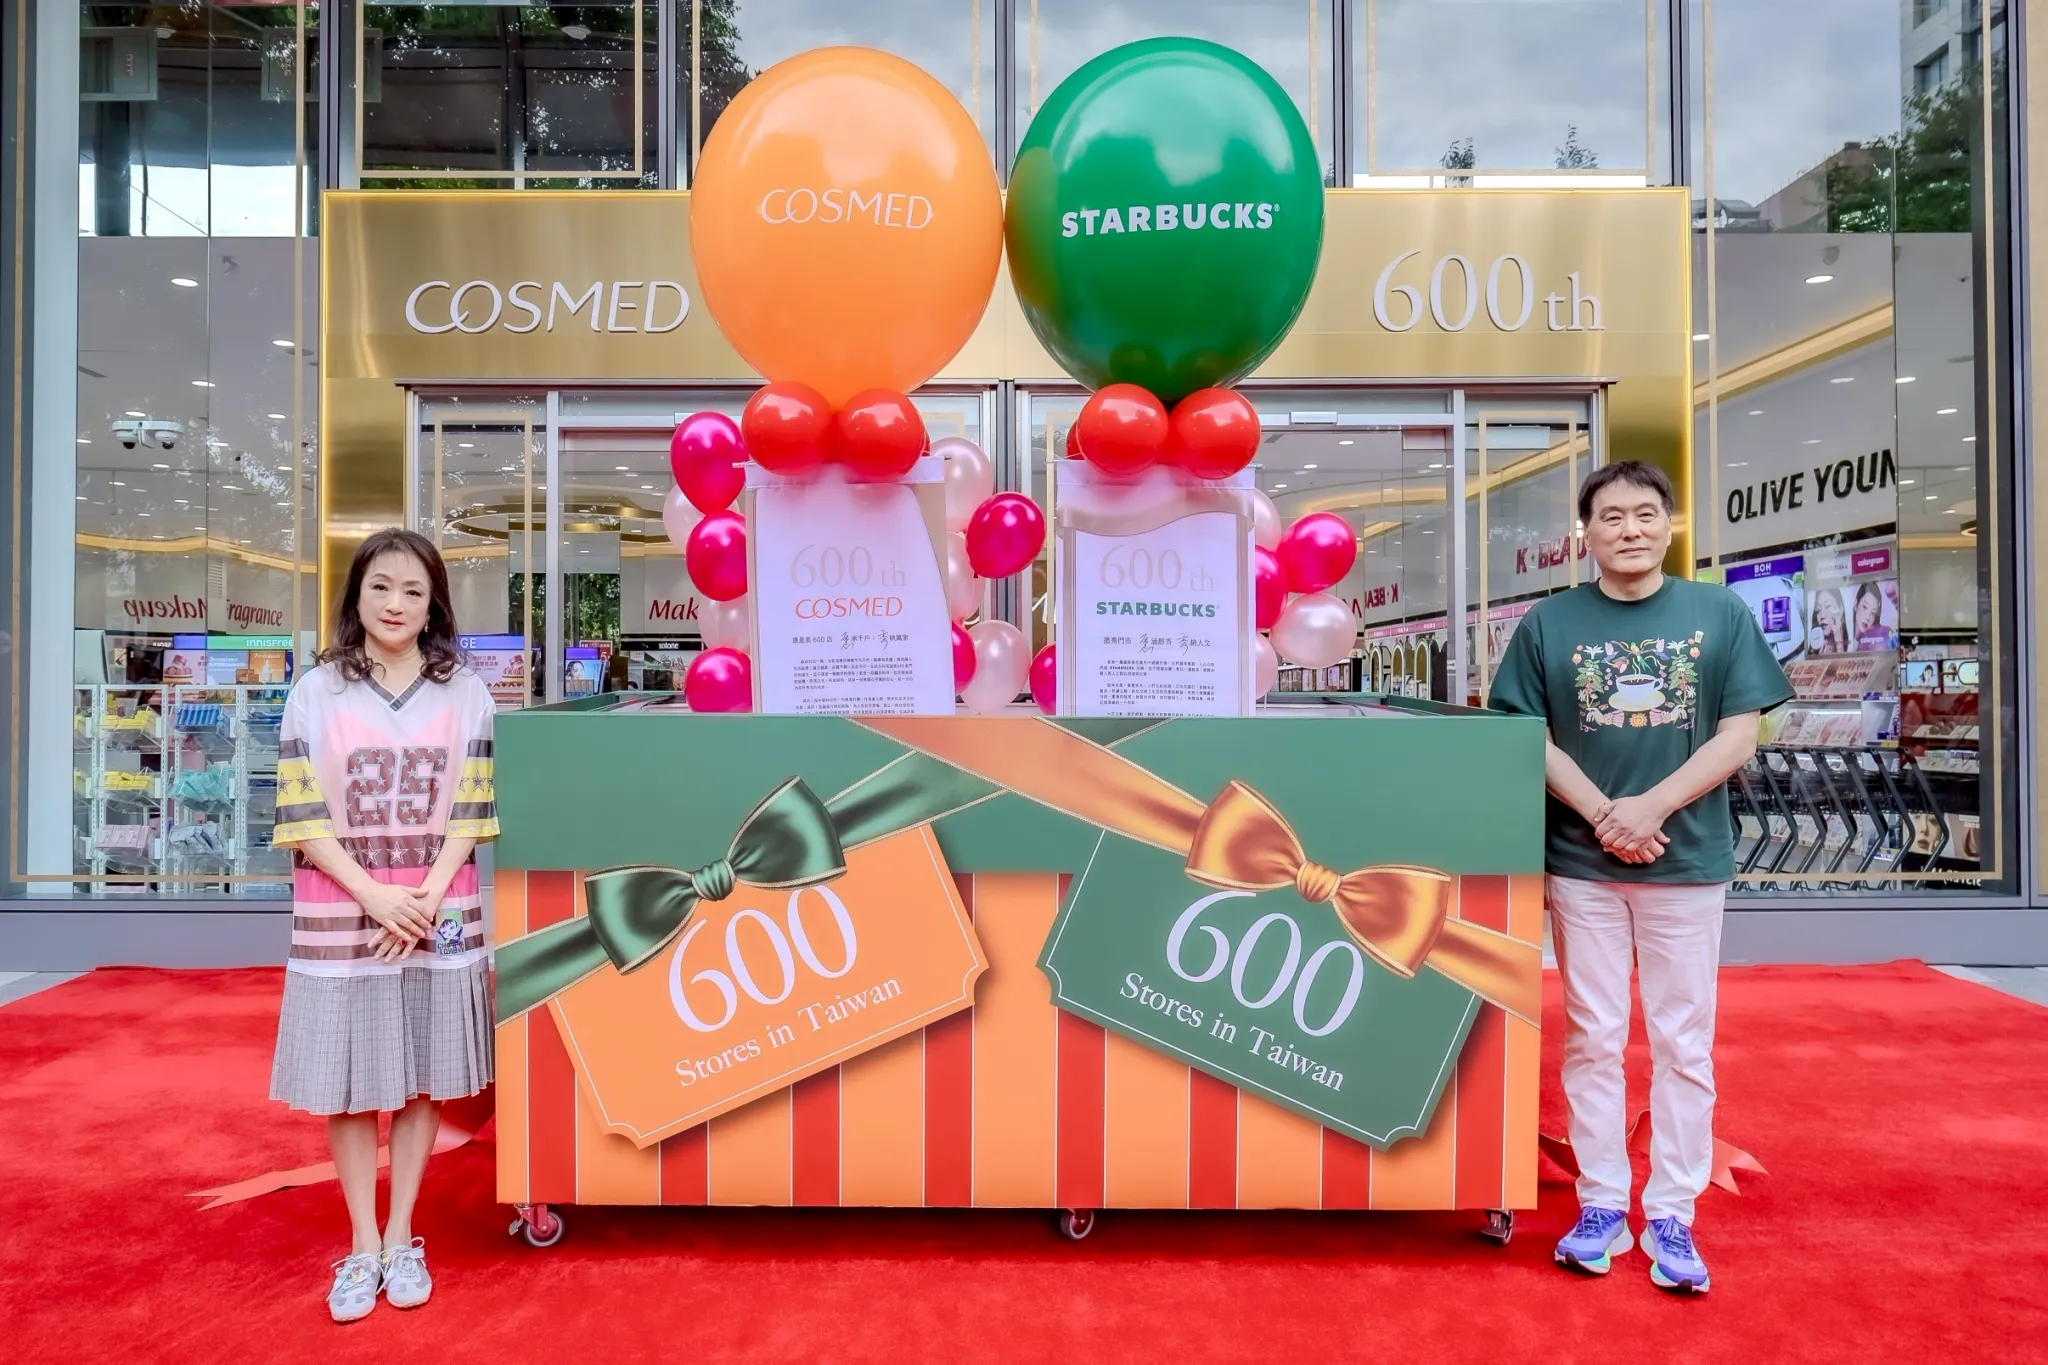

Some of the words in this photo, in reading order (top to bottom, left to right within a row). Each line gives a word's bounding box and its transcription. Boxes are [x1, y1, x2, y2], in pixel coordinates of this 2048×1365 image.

[760, 187, 933, 231] COSMED
[405, 280, 690, 334] COSMED
[1727, 472, 1804, 523] OLIVE
[1754, 562, 1771, 573] BOH
[227, 599, 283, 629] ragrance
[795, 597, 903, 619] COSMED
[460, 637, 477, 648] GE
[658, 642, 680, 650] solone
[345, 746, 449, 829] 25
[669, 884, 858, 1032] 600
[1166, 890, 1364, 1037] 600
[675, 1037, 761, 1087] Stores
[765, 1024, 795, 1046] in
[797, 976, 903, 1034] Taiwan
[1120, 972, 1205, 1027] Stores
[1209, 1013, 1237, 1044] in
[1249, 1026, 1345, 1092] Taiwan
